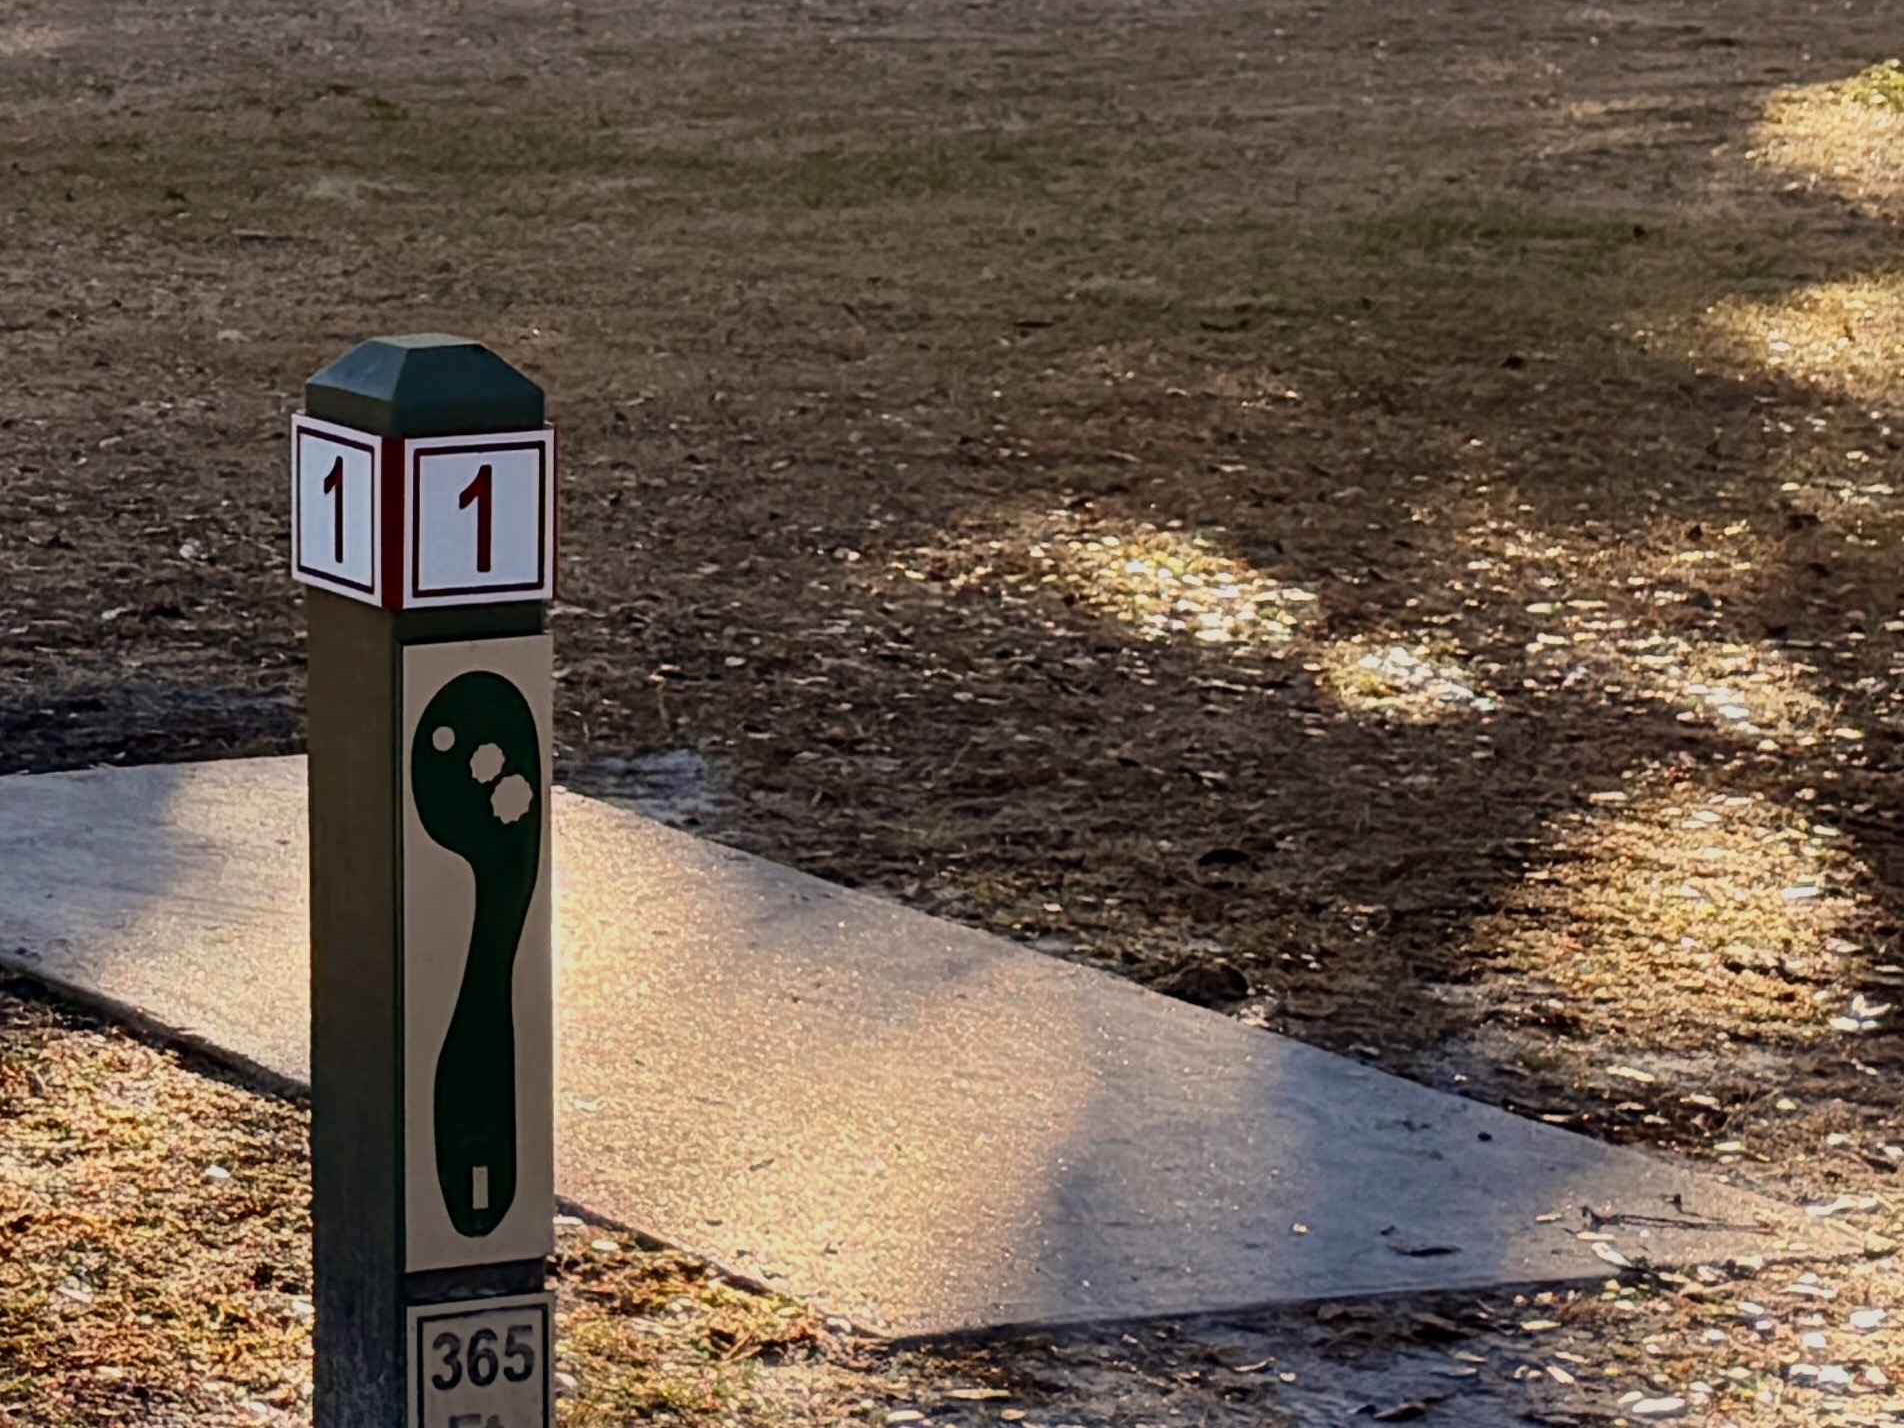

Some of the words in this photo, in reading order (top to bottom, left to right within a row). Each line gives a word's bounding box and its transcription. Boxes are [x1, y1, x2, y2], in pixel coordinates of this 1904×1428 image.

[323, 455, 344, 564] 1
[458, 464, 493, 573] 1
[431, 1324, 535, 1391] 365
